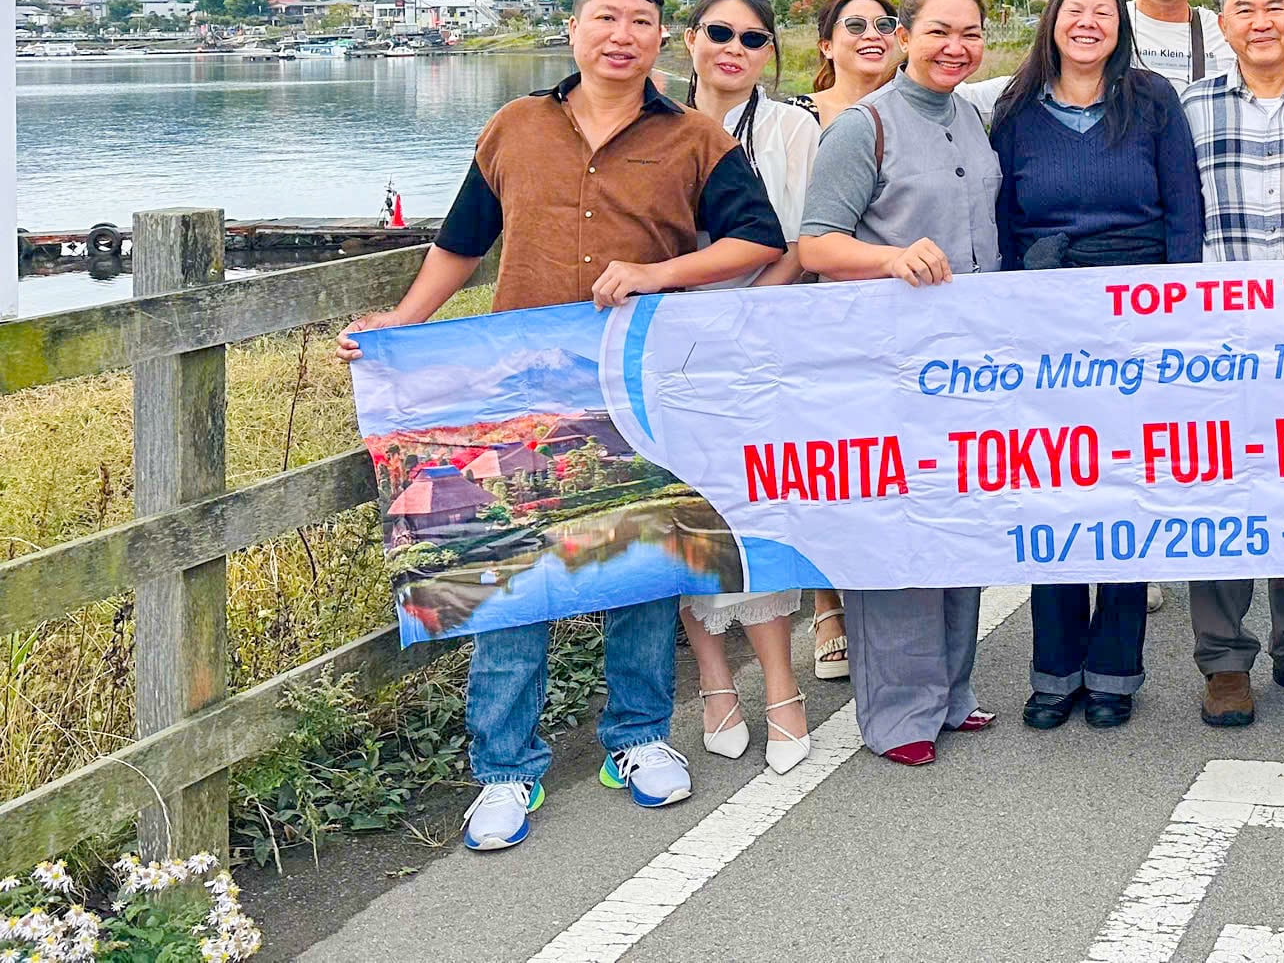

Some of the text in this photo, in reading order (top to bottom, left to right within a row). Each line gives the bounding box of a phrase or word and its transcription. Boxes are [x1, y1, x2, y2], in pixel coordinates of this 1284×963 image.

[1160, 48, 1184, 58] Klein
[1105, 282, 1187, 316] TOP
[1195, 279, 1274, 312] TEN
[918, 353, 1024, 396] Chào
[1035, 348, 1146, 396] Mừng
[1156, 342, 1260, 384] Đoàn
[743, 435, 909, 503] NARITA
[948, 425, 1099, 494] TOKYO
[1142, 420, 1233, 484] FUJI
[1006, 515, 1270, 564] 10/10/2025
